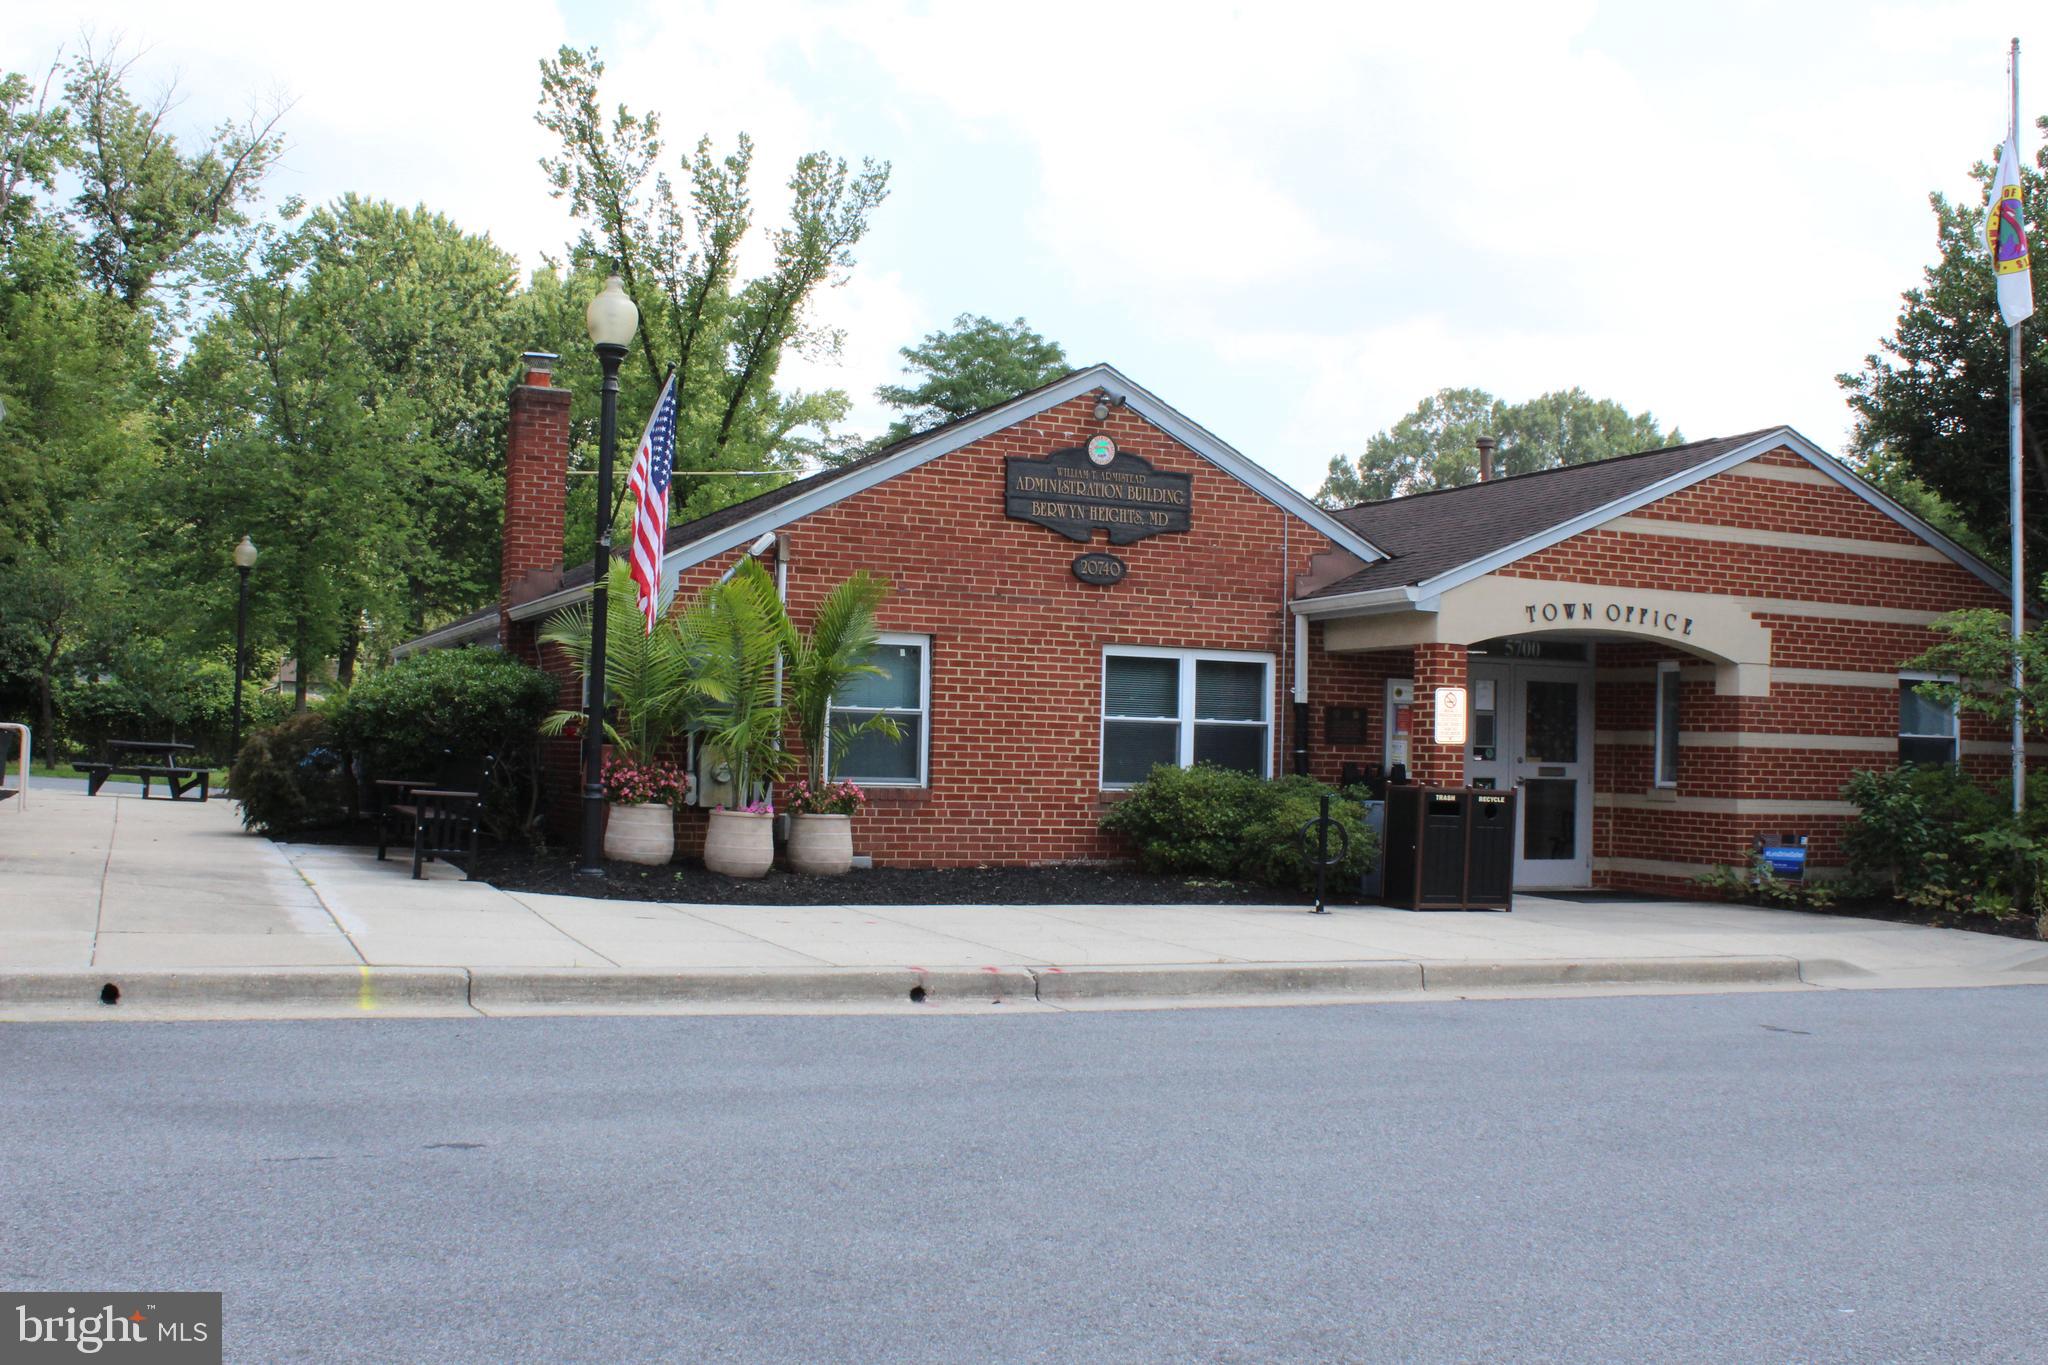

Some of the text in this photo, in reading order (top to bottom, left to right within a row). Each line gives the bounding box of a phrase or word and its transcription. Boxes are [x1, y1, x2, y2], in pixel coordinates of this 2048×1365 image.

[1056, 467, 1089, 479] WILLIAM
[1101, 471, 1146, 484] ARMISTEAD
[1016, 476, 1185, 505] ADMINISTRATION BUILDING
[1031, 501, 1169, 526] BERWYN HEIGHTS, MD
[1080, 559, 1121, 577] 20740
[1525, 602, 1694, 636] TOWN OFFICE
[1504, 640, 1541, 657] 5700
[1435, 794, 1457, 802] TRASH
[1478, 795, 1506, 803] RECYCLE
